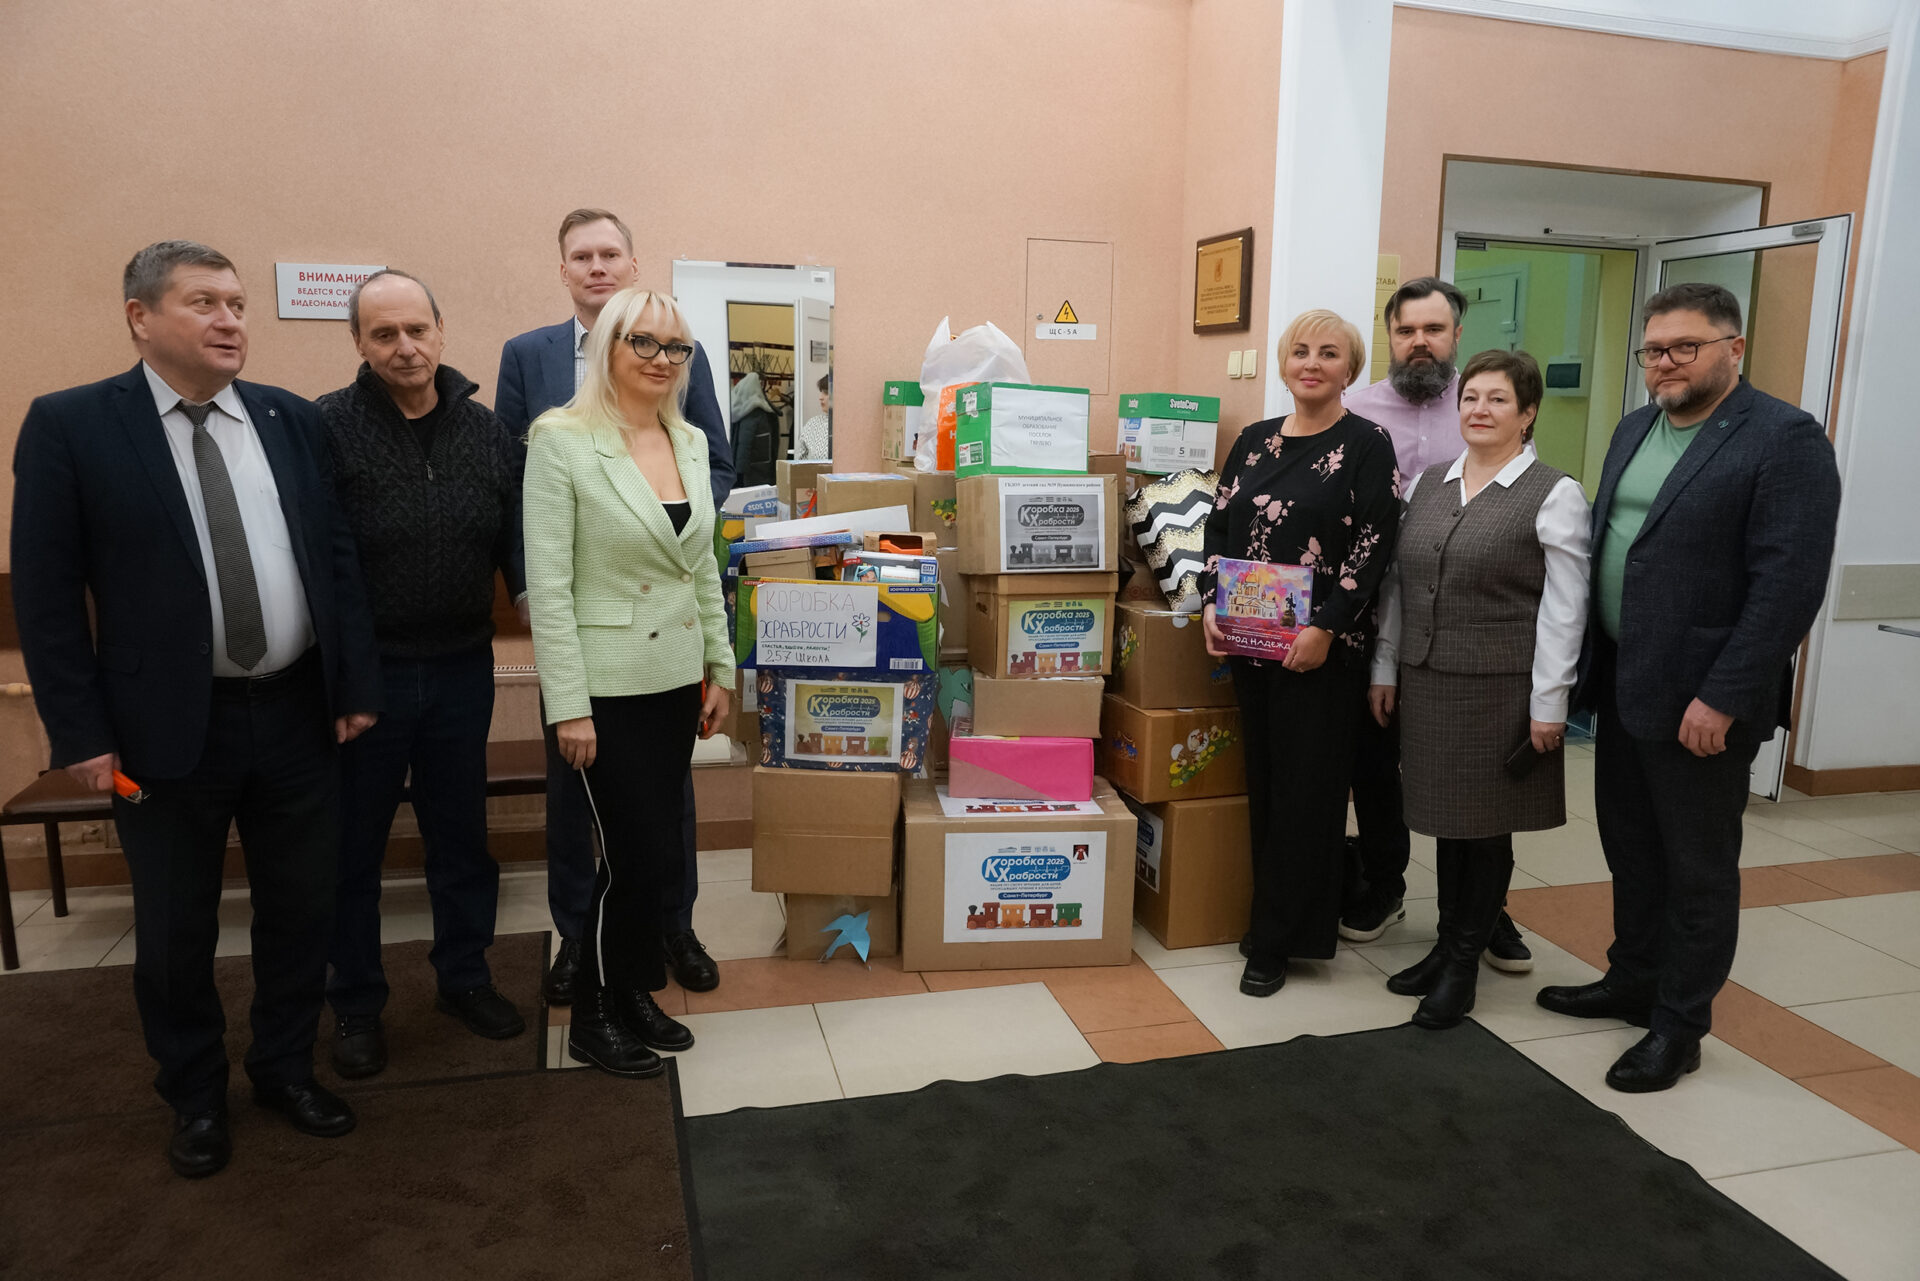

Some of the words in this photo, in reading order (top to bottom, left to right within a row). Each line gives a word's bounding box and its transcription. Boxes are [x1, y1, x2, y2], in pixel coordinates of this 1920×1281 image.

[297, 287, 333, 296] ВЕДЕТСЯ
[336, 288, 353, 296] СКР
[1179, 446, 1186, 455] 5
[1020, 504, 1065, 523] Коробка
[1029, 513, 1075, 527] Храбрости
[766, 589, 856, 612] КОРОБКА
[1024, 610, 1074, 631] Коробка
[1033, 620, 1085, 634] Храбрости
[760, 619, 848, 639] ХРАБРОСТИ
[1224, 634, 1248, 645] ОРОД
[795, 651, 830, 663] ШКОЛА
[809, 695, 860, 713] Коробка
[820, 704, 871, 717] Храбрости
[984, 856, 1045, 878] Коробка
[996, 867, 1059, 882] Храбрости
